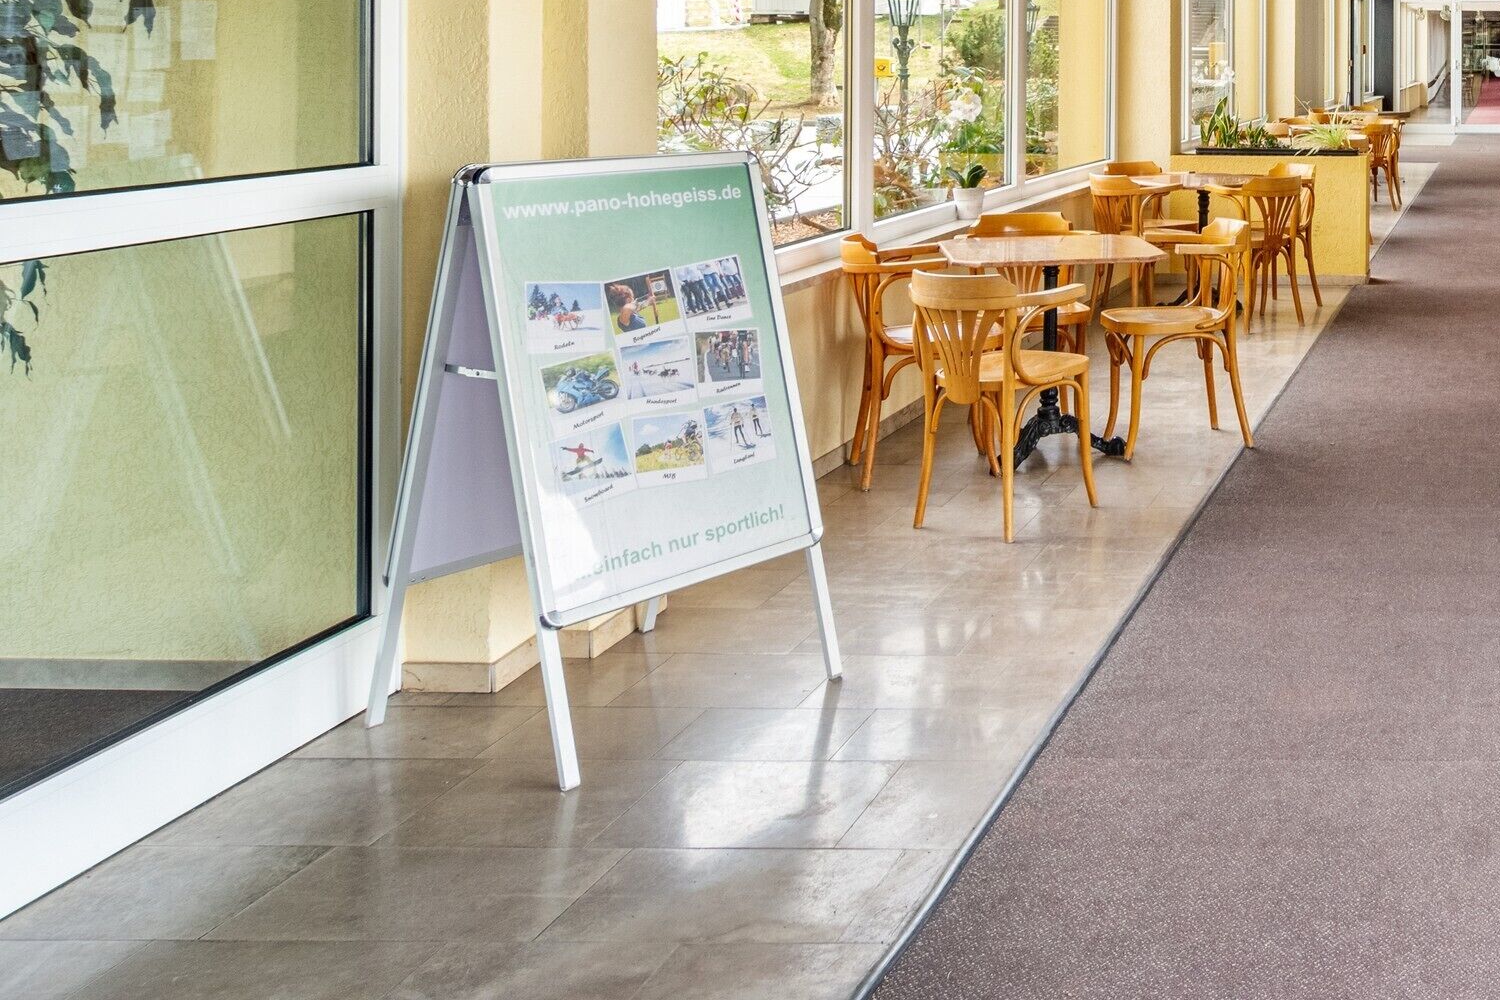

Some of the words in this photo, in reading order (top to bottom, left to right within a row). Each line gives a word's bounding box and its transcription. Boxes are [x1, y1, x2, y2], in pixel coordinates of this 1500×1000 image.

[632, 326, 661, 344] Bogensport
[553, 340, 575, 351] Rodeln
[646, 397, 677, 405] Hundesport
[572, 411, 605, 430] Motorsport
[583, 483, 614, 504] Snowboard
[668, 531, 701, 553] nur
[704, 503, 785, 543] sportlich!
